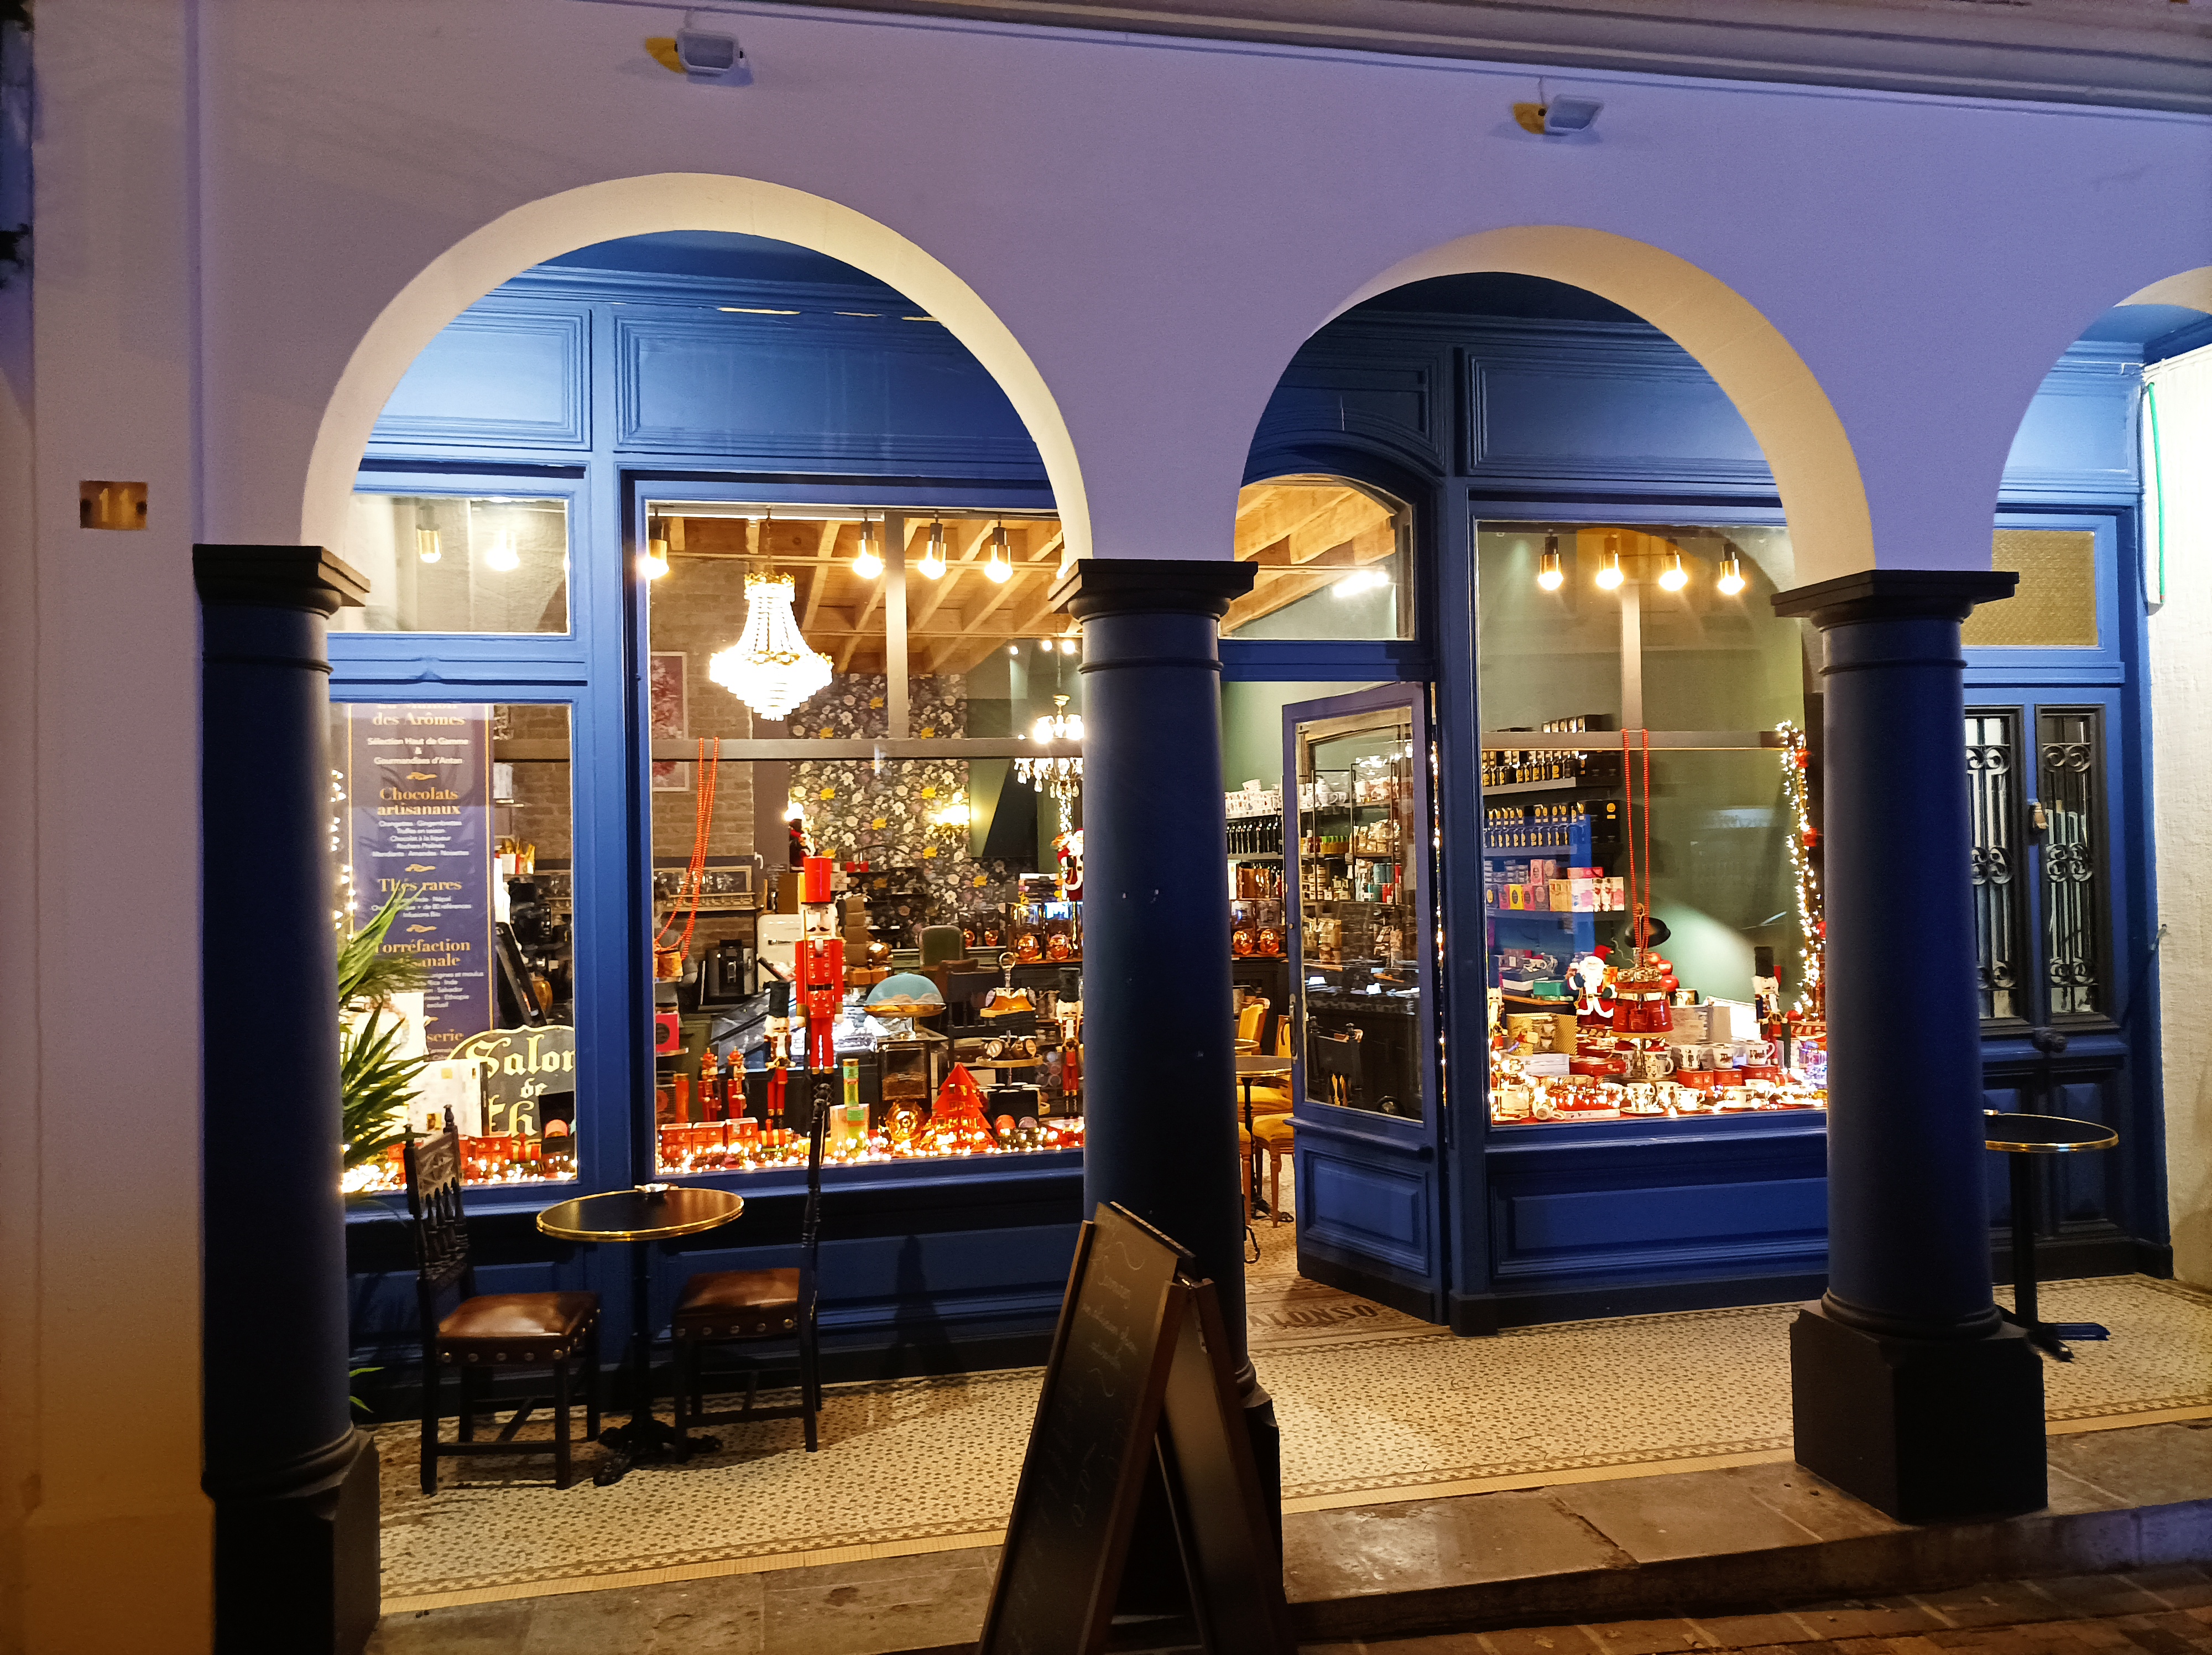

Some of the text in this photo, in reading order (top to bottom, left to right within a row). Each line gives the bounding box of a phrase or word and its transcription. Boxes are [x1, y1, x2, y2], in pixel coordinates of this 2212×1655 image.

[373, 711, 466, 726] des Arômes
[379, 787, 459, 800] Chocolats
[377, 803, 461, 815] artisanaux
[421, 881, 463, 891] rares
[376, 938, 471, 953] orréfaction
